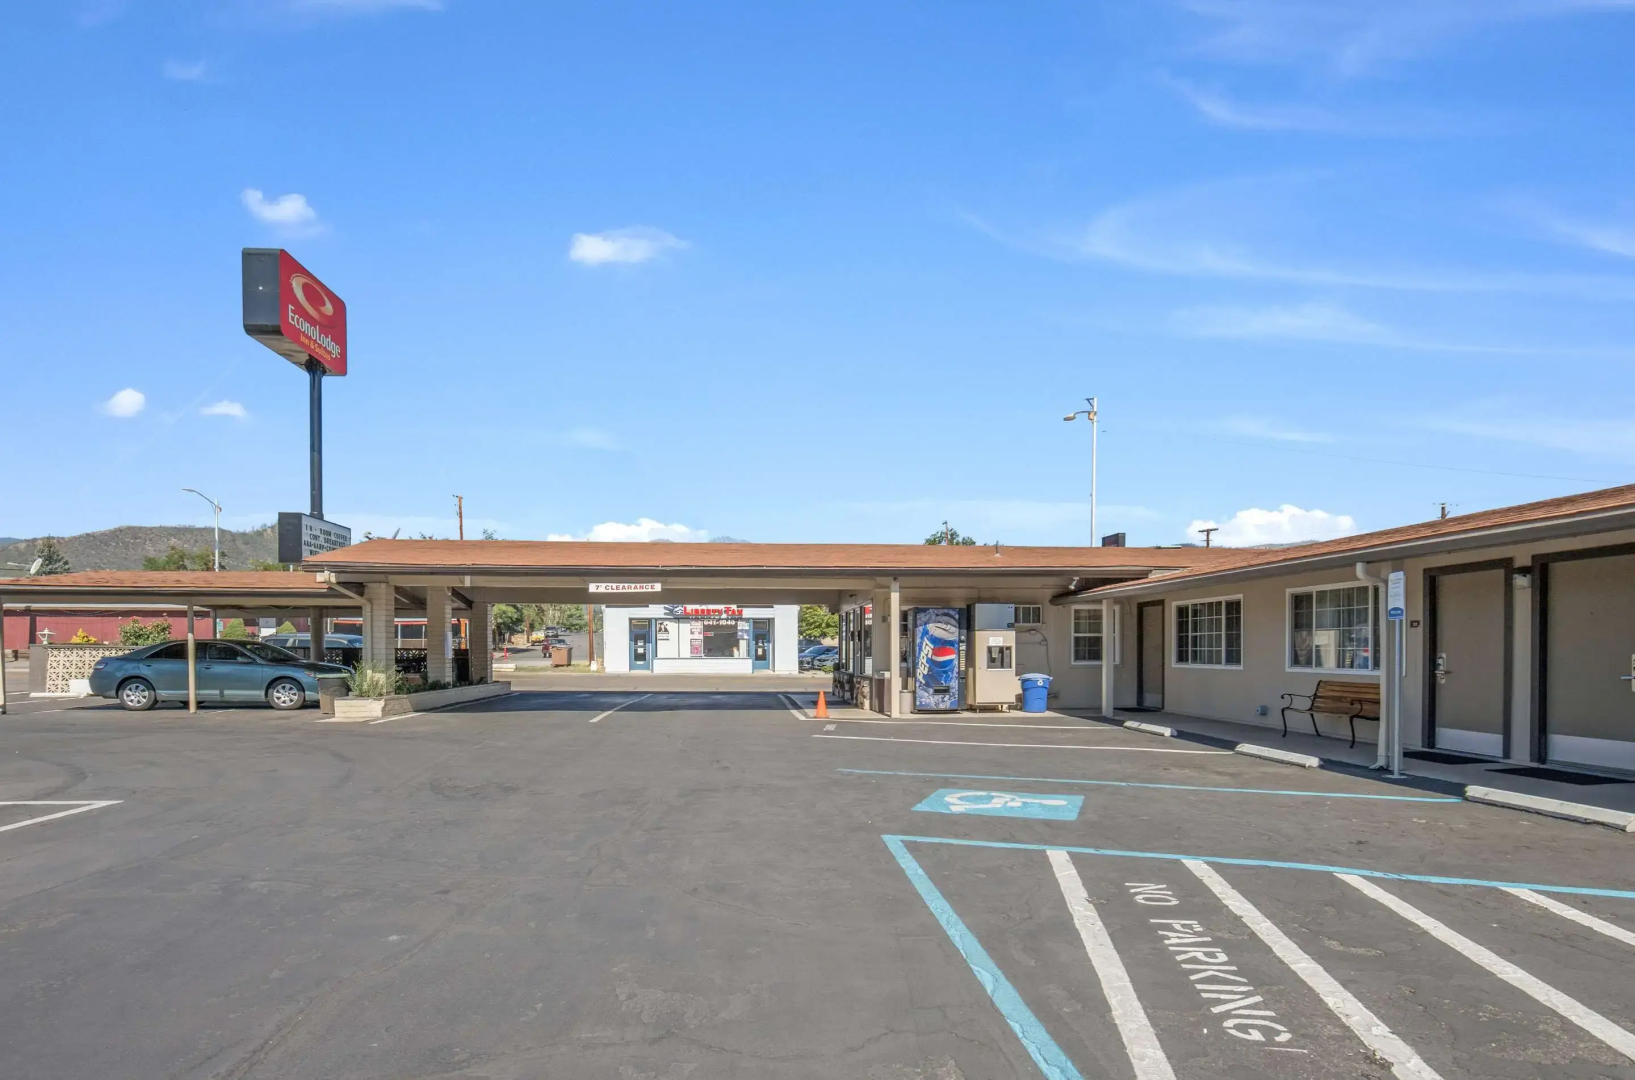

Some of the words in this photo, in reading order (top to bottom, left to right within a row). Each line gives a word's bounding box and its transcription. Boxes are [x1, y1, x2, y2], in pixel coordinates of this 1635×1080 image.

[300, 333, 310, 346] Inn
[315, 345, 331, 361] Suites
[320, 528, 332, 537] ROOM
[333, 532, 348, 542] COFFEE
[916, 637, 934, 684] PEPSI
[1124, 882, 1180, 906] NO
[1149, 918, 1292, 1042] PARKING
